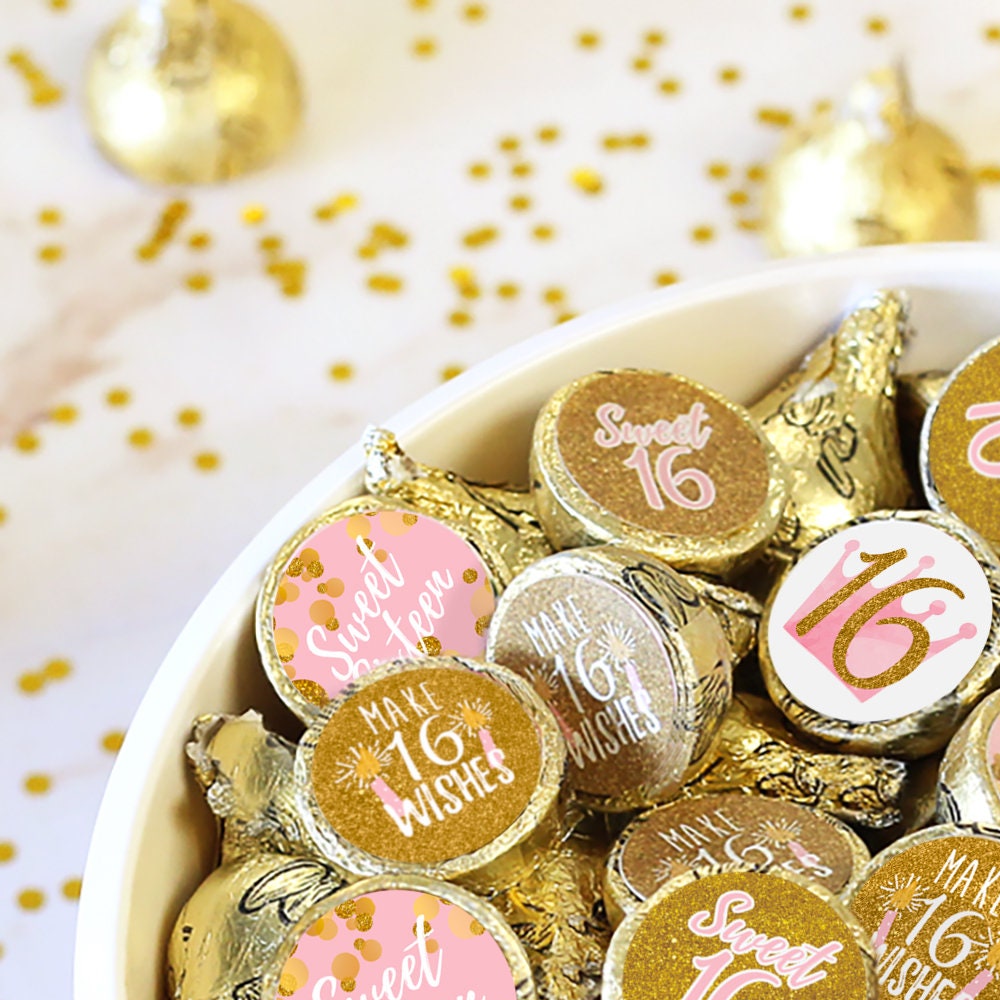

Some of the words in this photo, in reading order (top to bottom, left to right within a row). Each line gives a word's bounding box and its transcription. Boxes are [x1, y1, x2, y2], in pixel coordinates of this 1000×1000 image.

[595, 401, 712, 452] Sweet
[623, 446, 716, 512] 16
[306, 535, 405, 681] Sweet
[351, 569, 454, 679] teen
[522, 594, 592, 657] MAKE
[795, 547, 965, 690] 16
[358, 680, 444, 737] MAKE
[553, 637, 616, 714] 16
[388, 714, 465, 782] 16
[566, 689, 661, 769] WISHES
[382, 747, 516, 838] WISHES
[657, 808, 744, 852] MAKE
[687, 890, 839, 991] Sweet
[906, 893, 985, 968] 16
